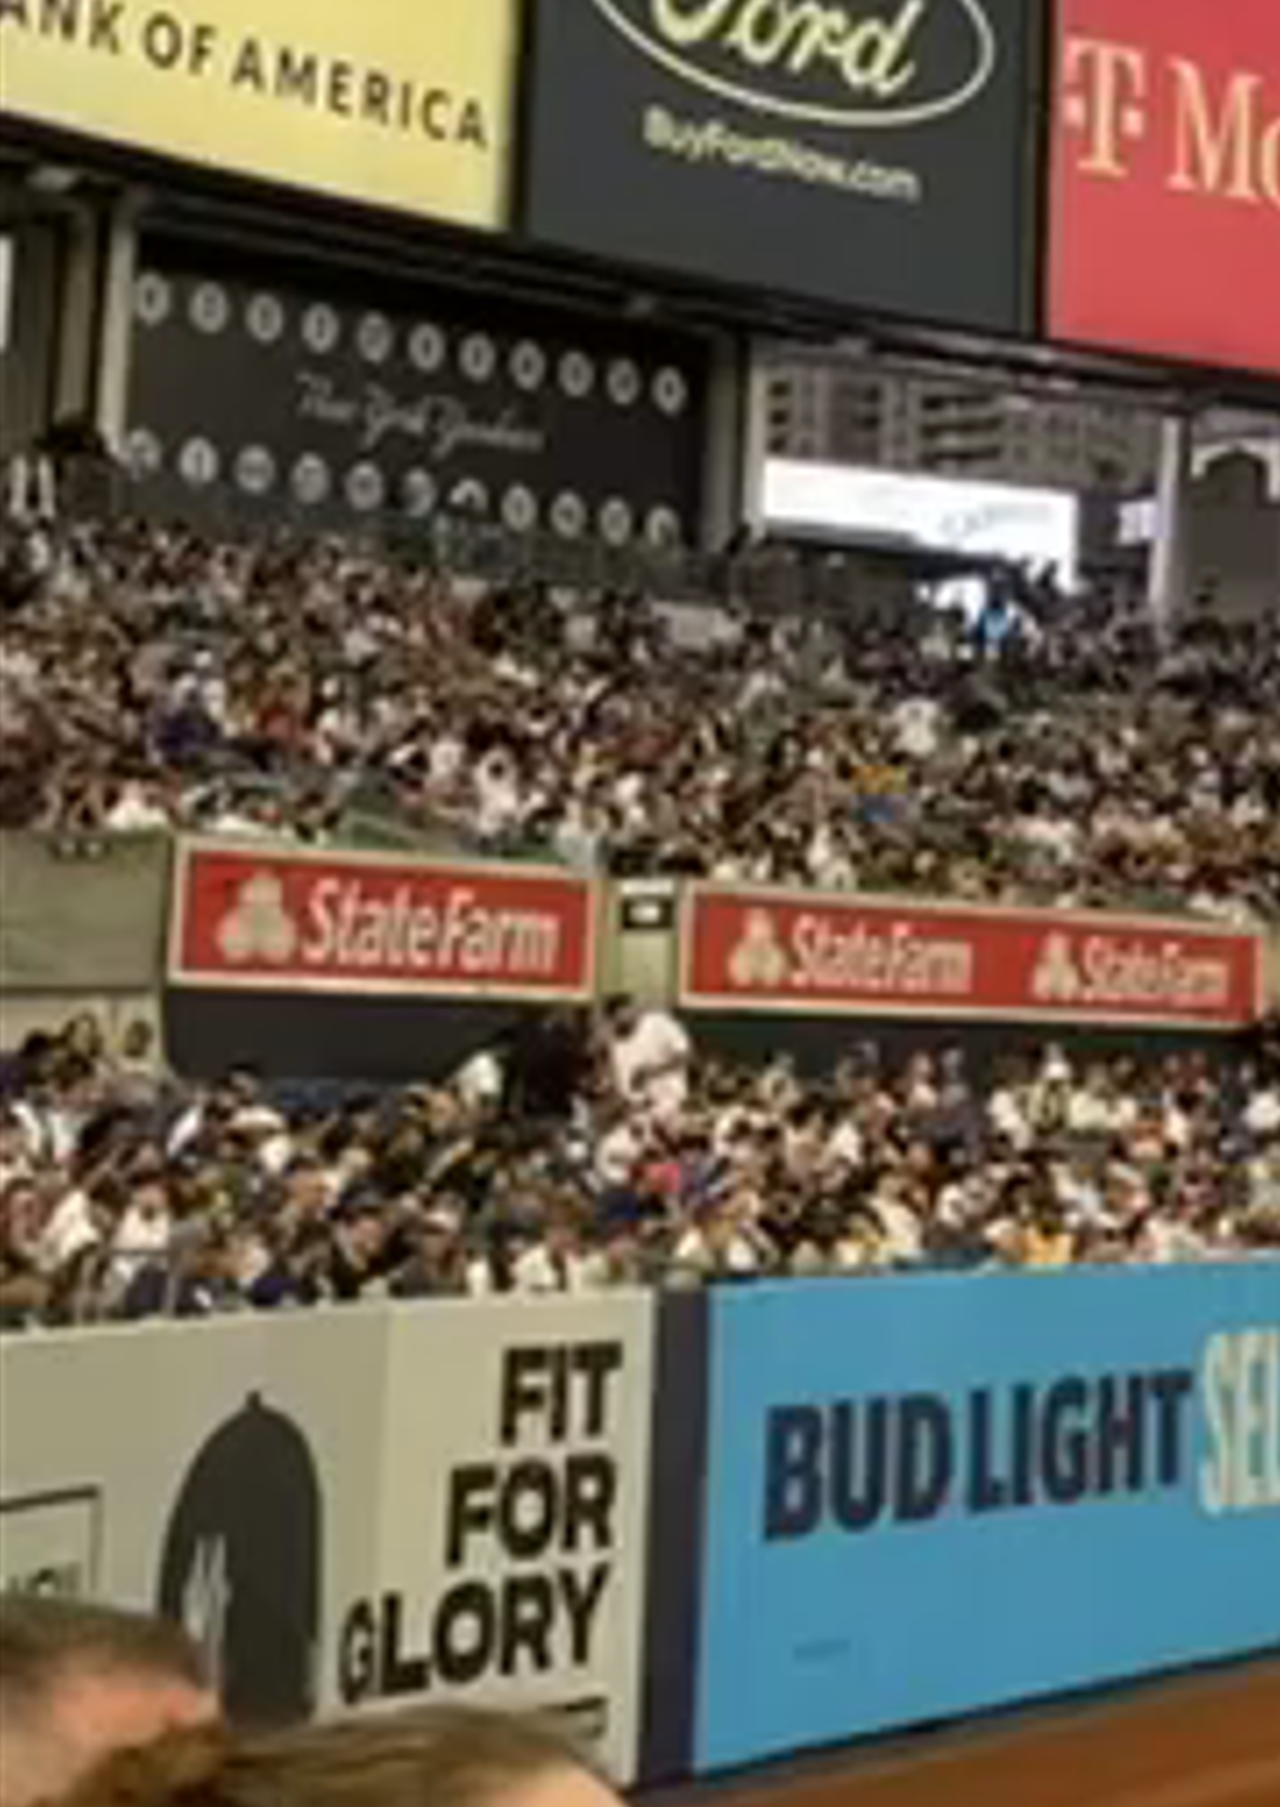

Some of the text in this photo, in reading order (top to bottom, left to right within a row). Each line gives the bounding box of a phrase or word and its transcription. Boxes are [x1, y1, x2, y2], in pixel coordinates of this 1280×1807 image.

[142, 12, 214, 84] OF
[236, 40, 490, 152] AMERICA
[500, 1341, 622, 1446] FIT
[763, 1393, 949, 1543] BUD
[968, 1369, 1194, 1509] LIGHT
[445, 1452, 616, 1566] FOR
[337, 1568, 611, 1704] GLORY
